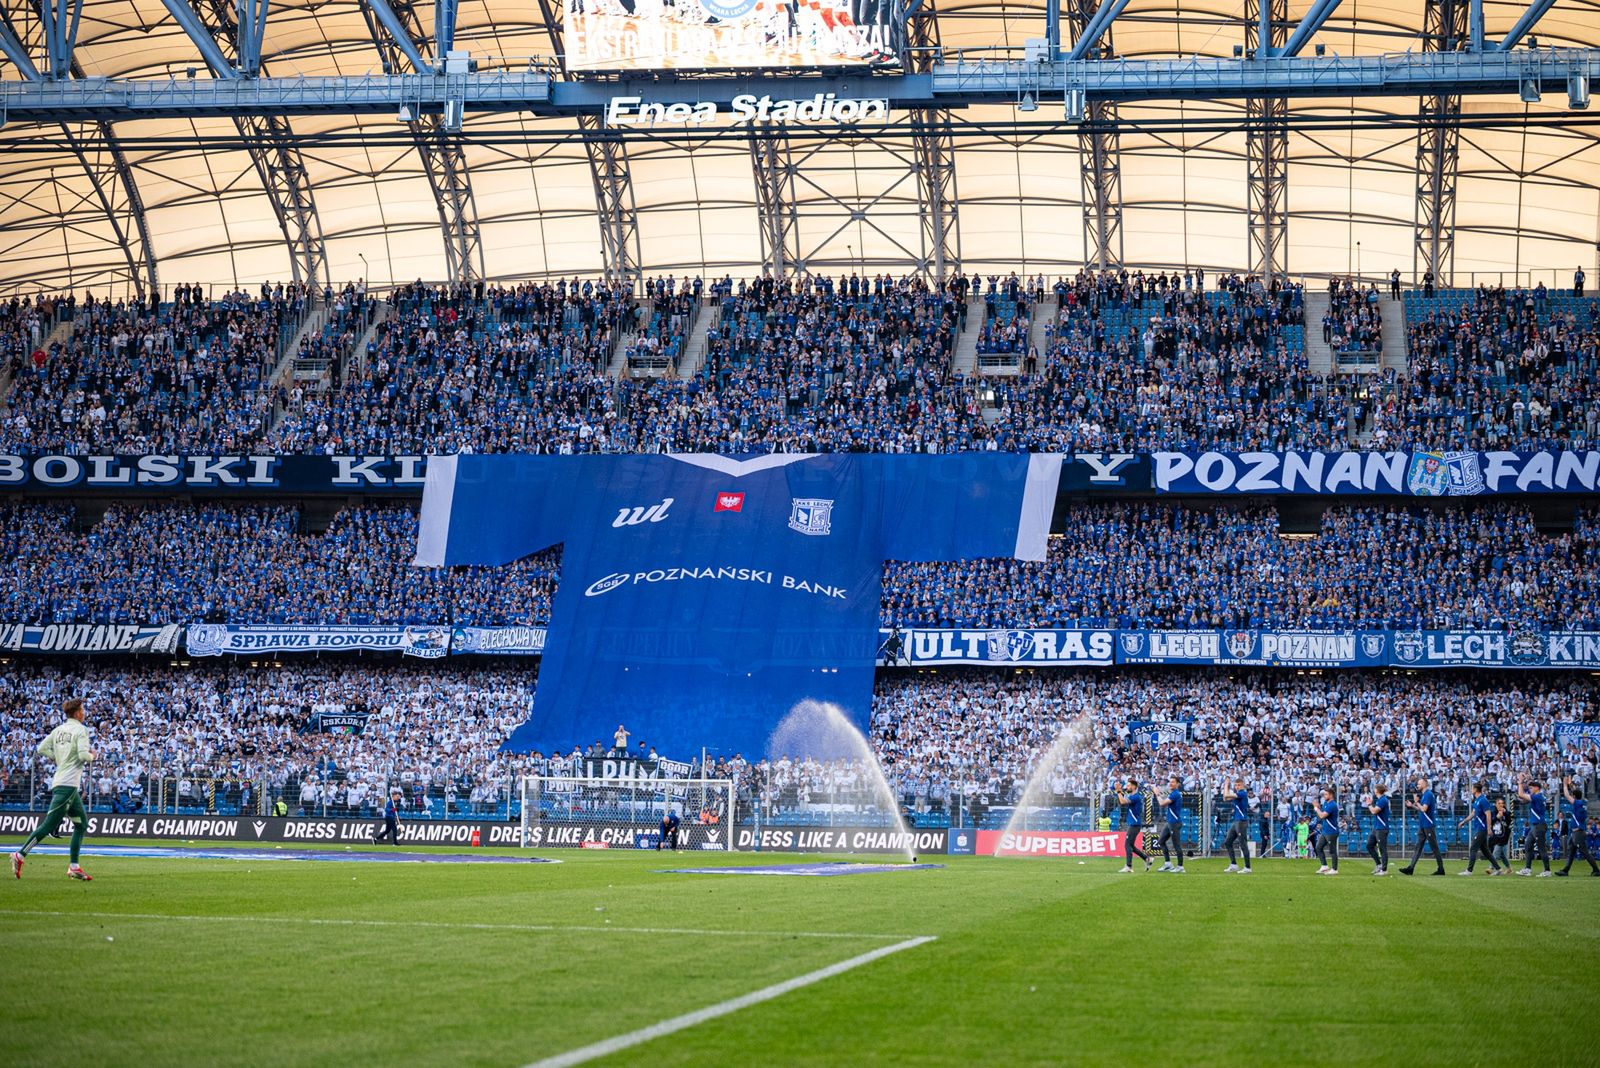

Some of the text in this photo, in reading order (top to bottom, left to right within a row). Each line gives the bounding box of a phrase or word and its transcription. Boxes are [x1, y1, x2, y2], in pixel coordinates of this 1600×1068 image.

[607, 94, 884, 124] Enea Stadion
[1152, 450, 1600, 492] POZNAŃ FAN
[596, 565, 847, 599] SGB POZNAŃSKI BANK
[231, 634, 403, 648] SPRAWA HONORU
[405, 645, 447, 657] KKS LECH
[1008, 636, 1032, 649] LPU
[1150, 634, 1219, 659] LECH
[1262, 630, 1356, 660] POZNAŃ
[1427, 635, 1505, 660] LECH
[322, 717, 364, 728] ESKADRA
[1133, 723, 1185, 736] RATAJSCY
[1558, 725, 1581, 735] LECH
[0, 815, 40, 832] PION
[101, 817, 132, 834] LIKE
[133, 819, 148, 835] A
[152, 819, 238, 837] CHAMPION
[283, 821, 336, 840] DRESS
[340, 823, 375, 840] LIKE
[396, 824, 481, 842] CHAMPION
[547, 826, 581, 843] LIKE
[584, 827, 596, 843] A
[601, 827, 691, 846] CHAN
[798, 831, 828, 848] LIKE
[829, 832, 847, 848] A
[853, 832, 944, 850] CHAMPION
[1001, 833, 1119, 855] SUPERBET
